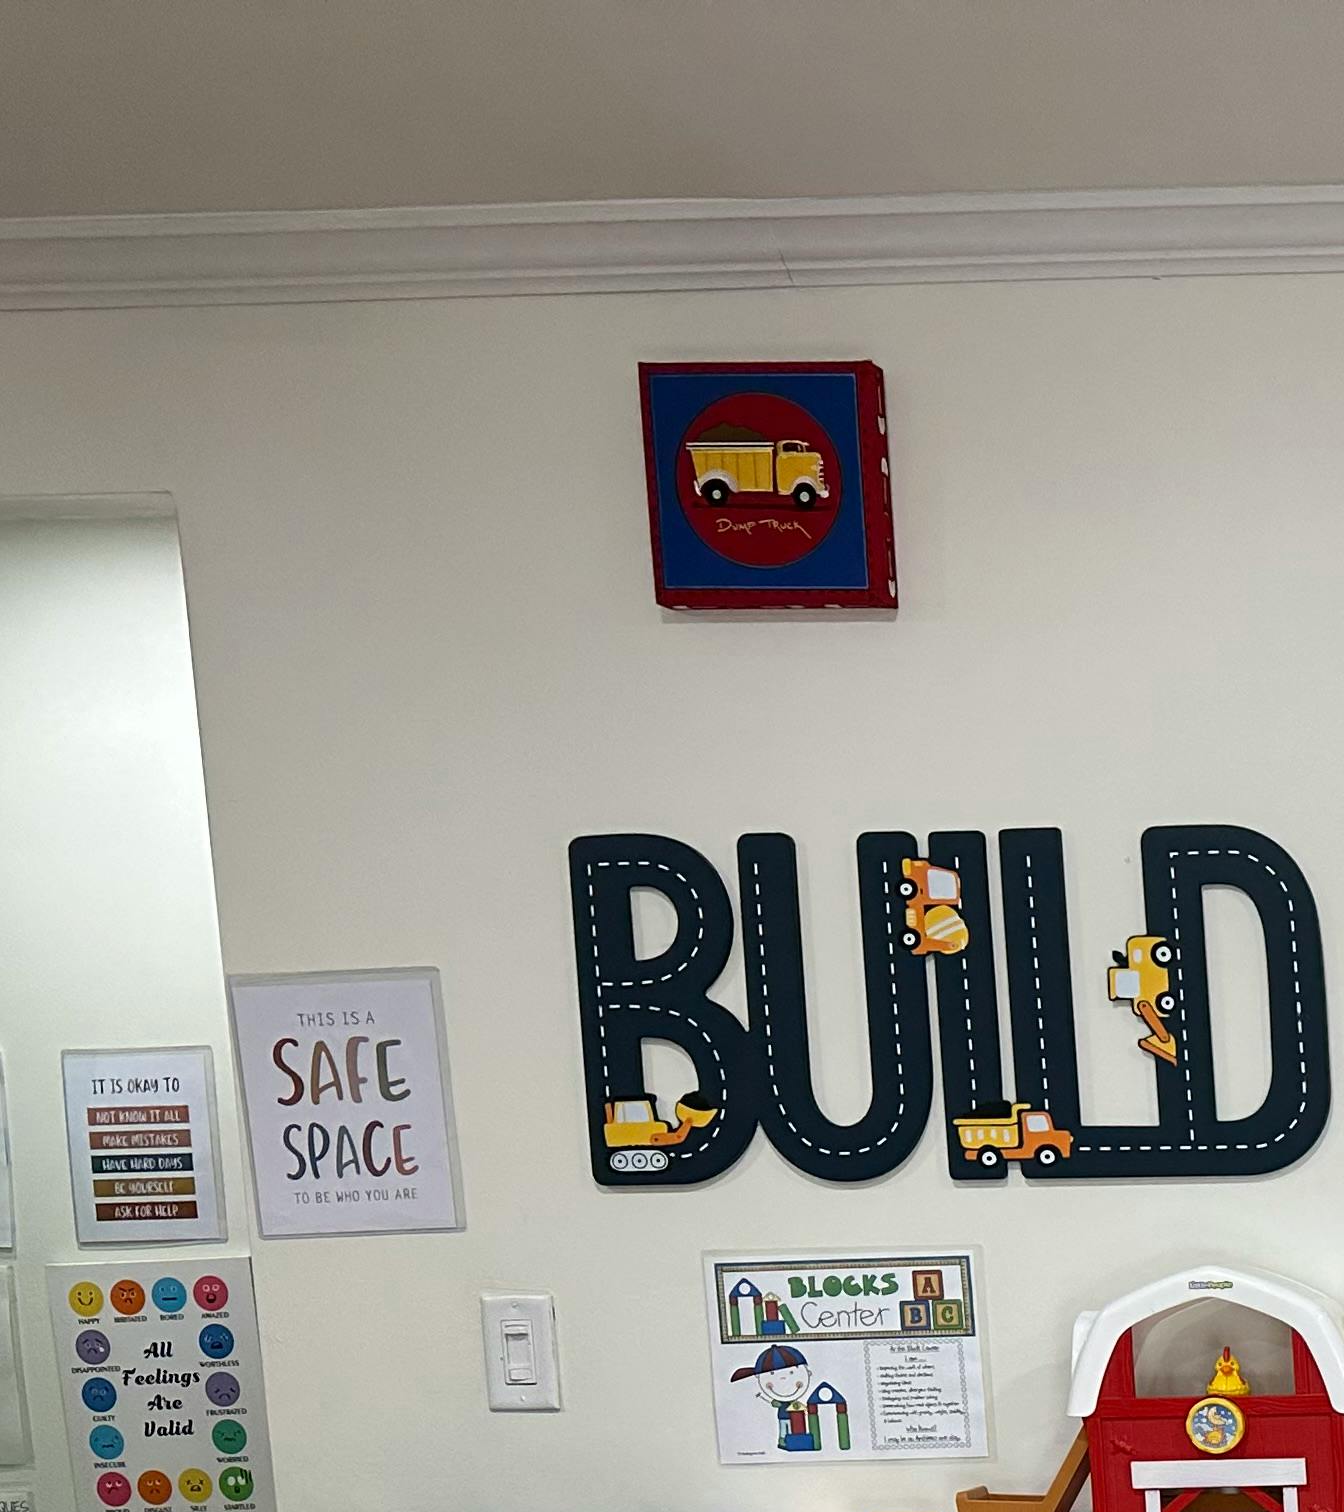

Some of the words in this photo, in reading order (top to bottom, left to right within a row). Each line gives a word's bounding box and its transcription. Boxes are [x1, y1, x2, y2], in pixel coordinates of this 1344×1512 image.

[568, 824, 1331, 1186] BUILD
[297, 1012, 335, 1027] THIS
[343, 1011, 360, 1026] IS
[366, 1011, 375, 1024] A
[273, 1036, 411, 1106] SAFE
[92, 1079, 106, 1095] IT
[111, 1078, 123, 1094] IS
[127, 1078, 159, 1094] OKAY
[162, 1077, 180, 1092] TO
[96, 1111, 115, 1124] NOT
[118, 1110, 147, 1123] KNOW
[150, 1110, 161, 1122] IT
[164, 1110, 180, 1121] ALL
[102, 1135, 128, 1147] MAKE
[131, 1133, 179, 1146] MISTAKES
[283, 1120, 419, 1180] SPACE
[102, 1158, 128, 1171] HAVE
[130, 1158, 156, 1170] HARD
[158, 1157, 182, 1169] DAYS
[114, 1182, 126, 1194] BE
[128, 1181, 174, 1194] YOURSELF
[294, 1192, 309, 1204] TO
[315, 1191, 331, 1204] BE
[336, 1190, 360, 1203] WHO
[366, 1189, 389, 1201] YOU
[395, 1187, 419, 1201] ARE
[114, 1206, 132, 1218] ASK
[135, 1205, 152, 1218] FOR
[155, 1205, 178, 1217] HELP
[788, 1272, 899, 1298] BLOCKS
[921, 1277, 936, 1294] A
[801, 1301, 890, 1328] Center
[143, 1341, 174, 1359] All
[121, 1368, 201, 1388] Feelings
[148, 1394, 183, 1411] Are
[144, 1419, 194, 1437] Valid
